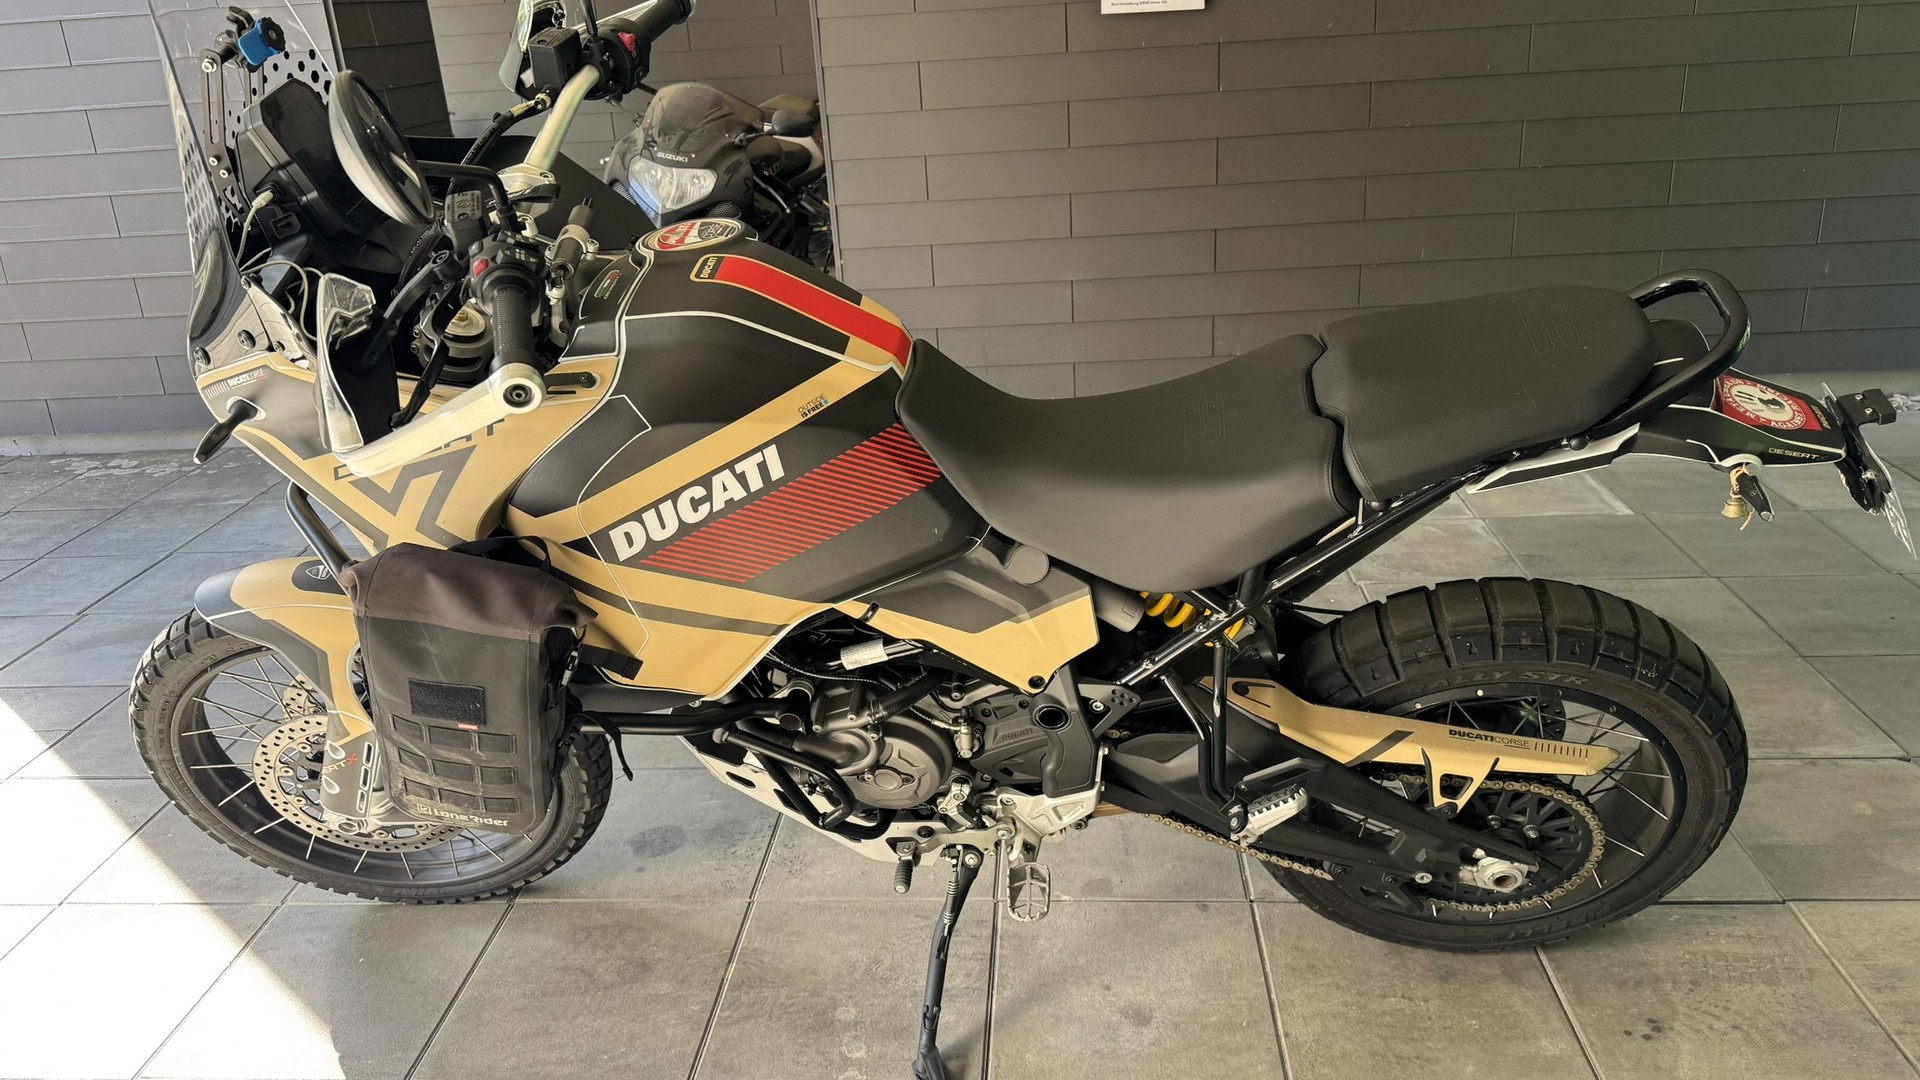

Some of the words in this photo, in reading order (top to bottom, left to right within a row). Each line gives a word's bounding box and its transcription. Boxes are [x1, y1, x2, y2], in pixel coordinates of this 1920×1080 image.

[657, 151, 688, 163] SUZUKI
[700, 257, 718, 278] DUCATI
[798, 393, 826, 413] OUTSIDE
[807, 402, 825, 415] FREE
[608, 443, 785, 562] DUCATI
[1521, 670, 1590, 686] STR
[1001, 728, 1033, 741] DUCATI
